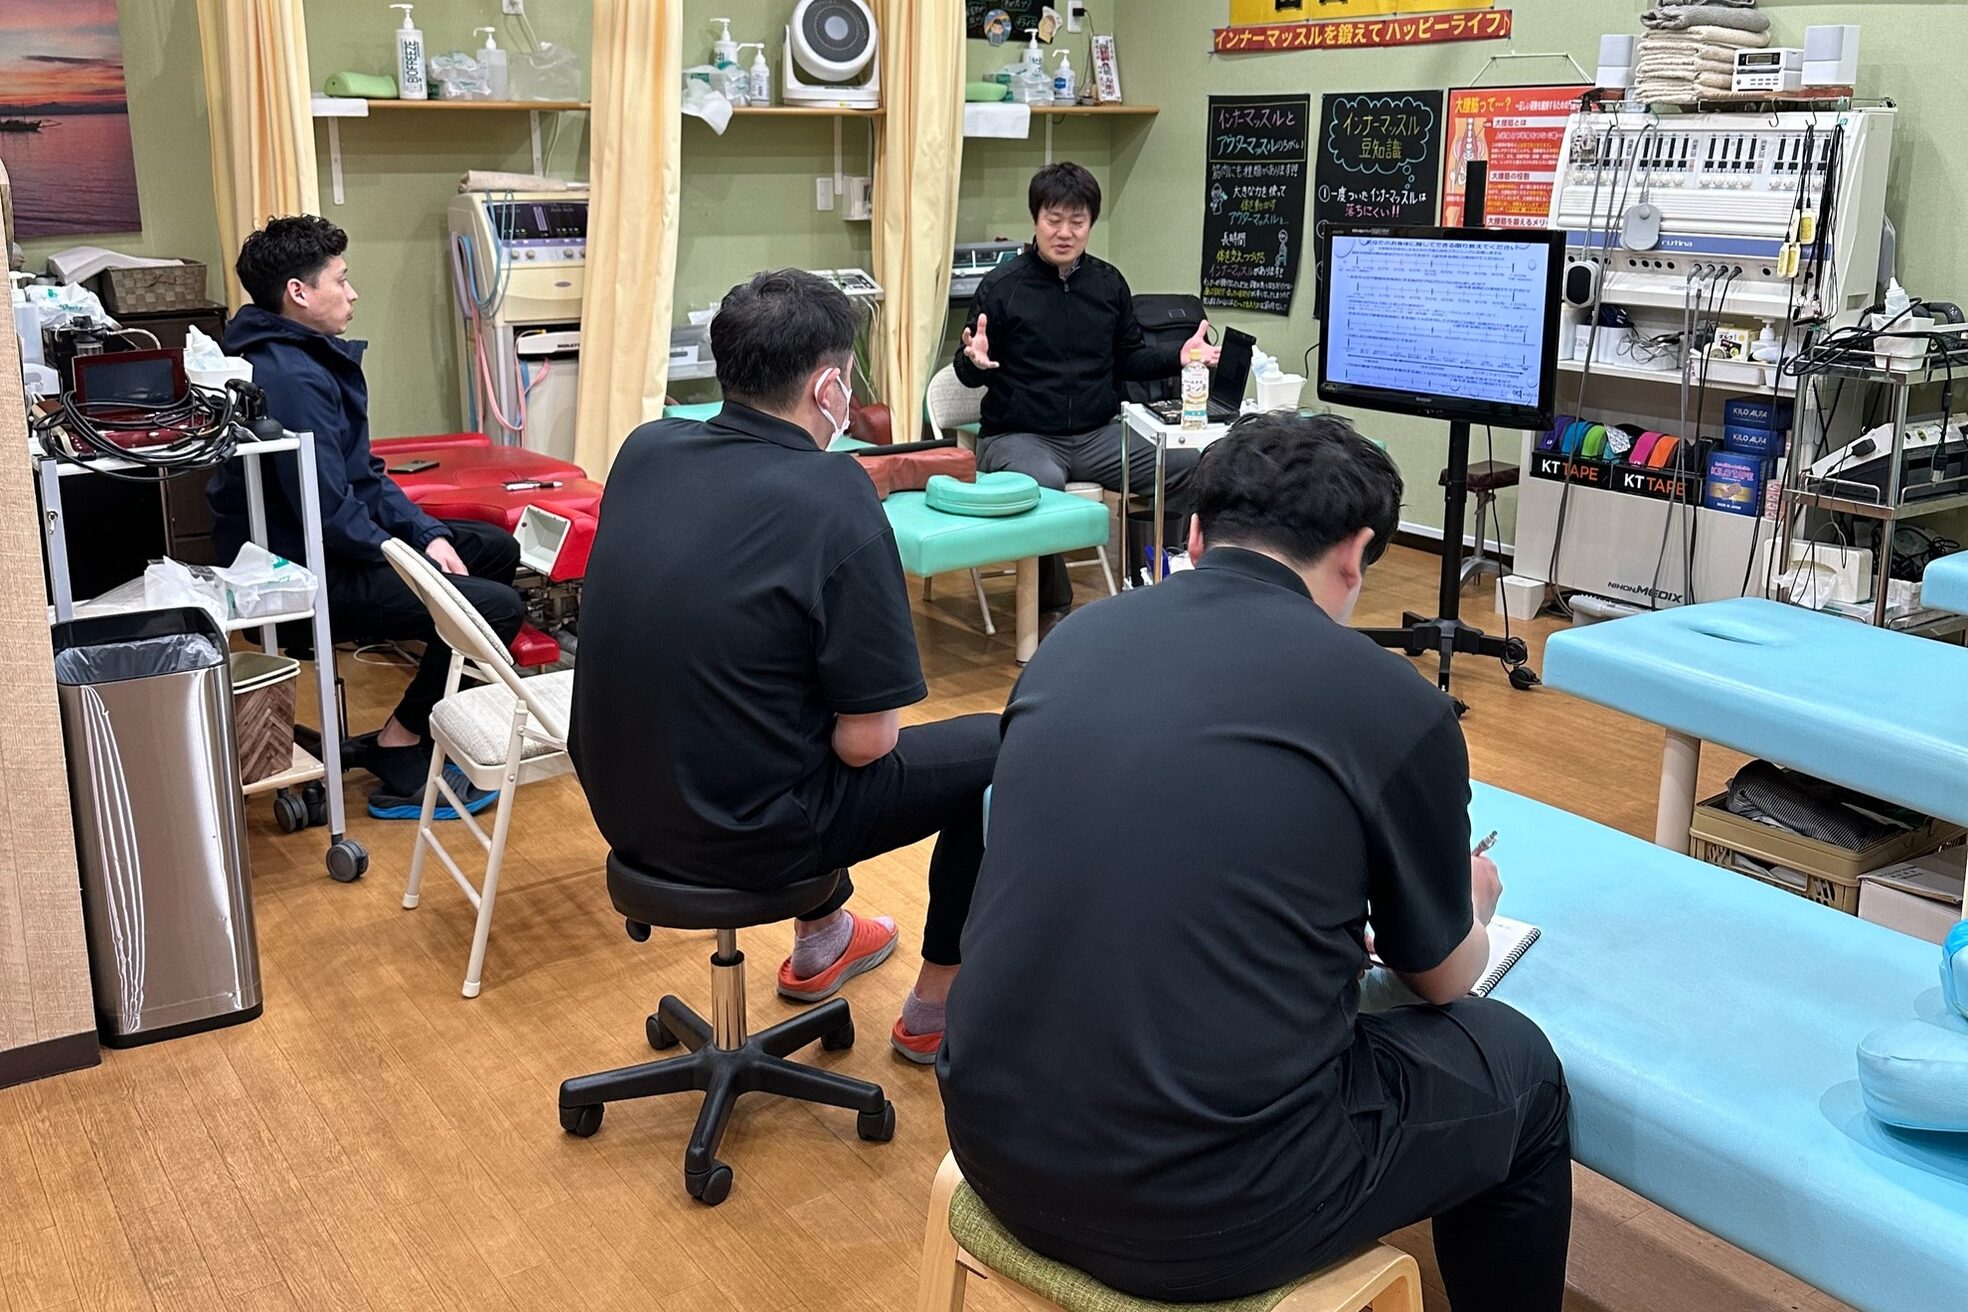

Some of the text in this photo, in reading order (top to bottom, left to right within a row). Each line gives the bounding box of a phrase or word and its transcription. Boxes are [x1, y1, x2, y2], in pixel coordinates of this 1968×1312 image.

[1219, 109, 1295, 130] インナーマッスルと
[1342, 112, 1420, 136] インナーマッスル
[1358, 138, 1402, 159] 豆知識
[1221, 231, 1246, 247] 長時間
[1733, 407, 1767, 418] KILO ALFA
[1732, 433, 1767, 444] KILO ALFA
[1541, 459, 1599, 481] KT TAPE
[1624, 473, 1686, 496] KT TAPE
